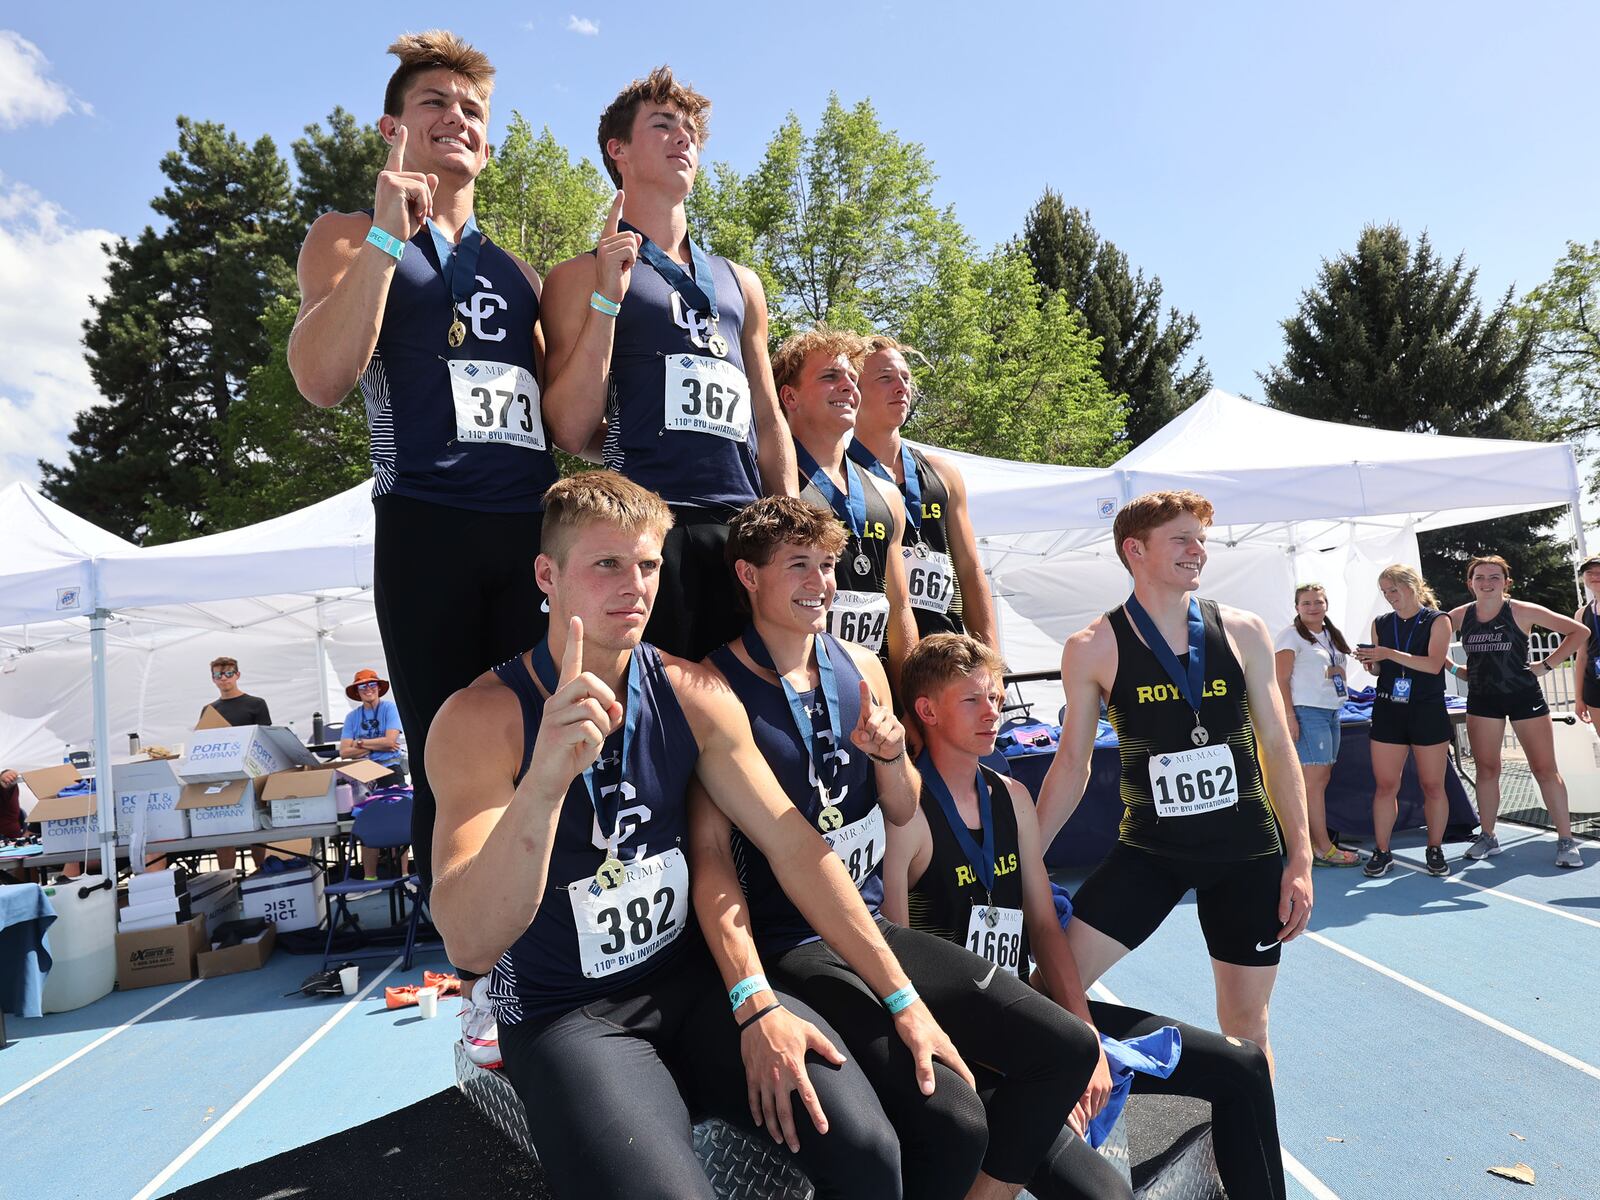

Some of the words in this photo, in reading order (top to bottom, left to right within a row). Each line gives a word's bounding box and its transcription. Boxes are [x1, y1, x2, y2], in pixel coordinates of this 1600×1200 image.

[471, 386, 533, 433] 373
[681, 378, 740, 423] 367
[693, 419, 707, 428] BYU
[488, 431, 503, 440] BYU
[504, 432, 540, 446] INVITATIONAL
[908, 567, 951, 601] 667
[826, 610, 885, 643] 1664
[1136, 679, 1228, 704] ROYLS
[190, 750, 240, 761] COMPANY
[192, 742, 230, 753] PORT
[231, 741, 241, 750] &
[1155, 765, 1235, 805] 1662
[121, 802, 172, 815] COPANY
[196, 809, 245, 821] COMPANY
[1180, 804, 1193, 813] BYU
[1194, 797, 1232, 811] INVITATIONAL
[842, 838, 875, 883] 81
[597, 886, 676, 955] 382
[618, 953, 636, 966] BYU
[971, 930, 1019, 968] 1668
